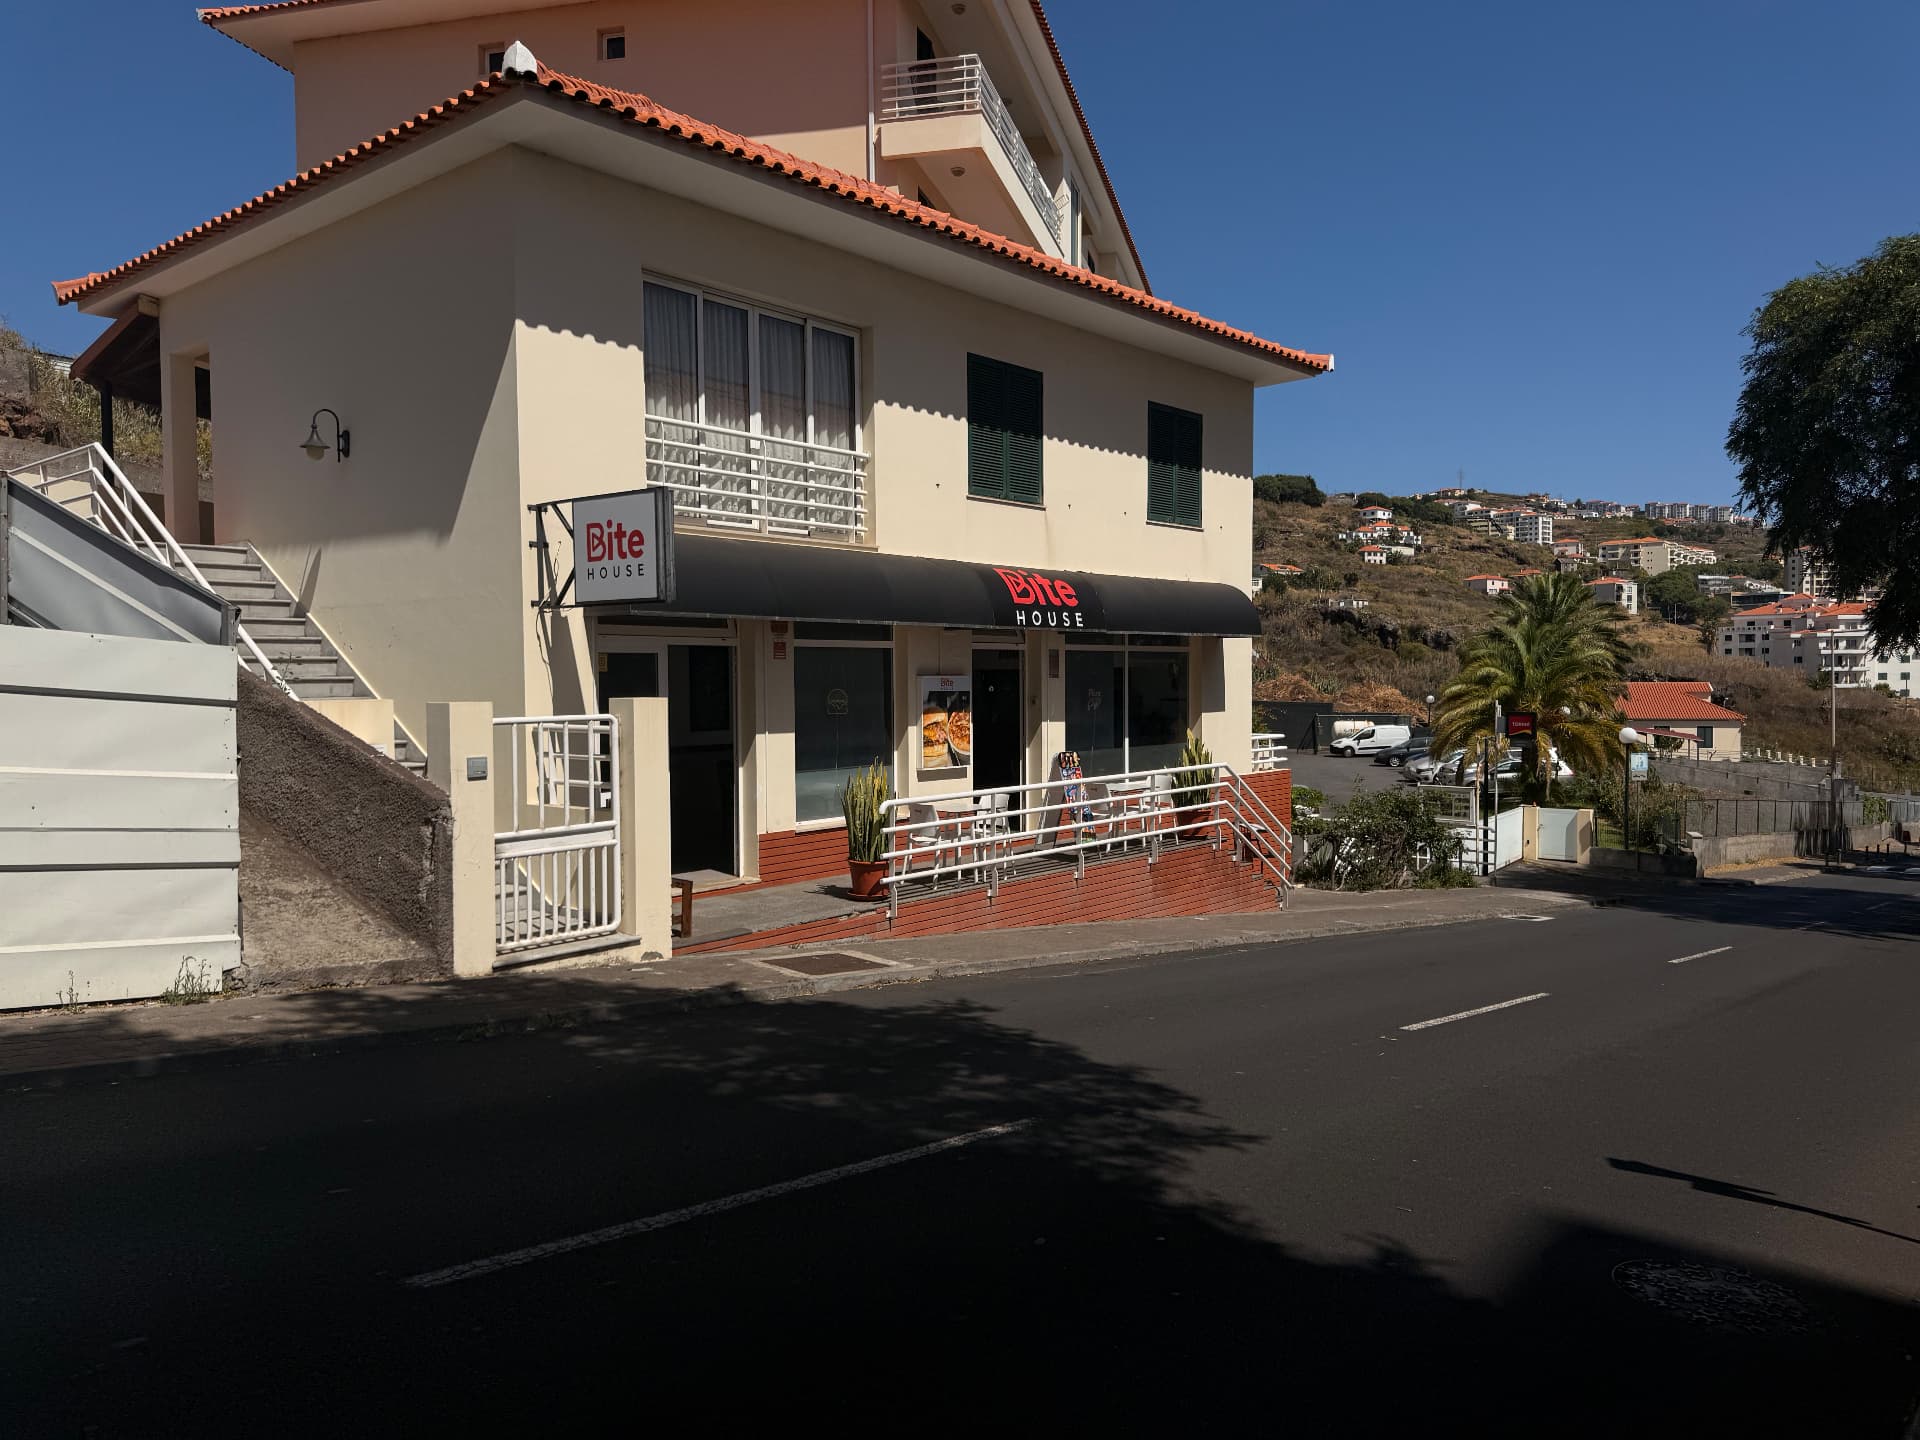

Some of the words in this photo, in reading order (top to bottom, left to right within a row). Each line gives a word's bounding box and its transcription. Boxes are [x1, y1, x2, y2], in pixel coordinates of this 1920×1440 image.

[586, 519, 645, 563] Bite
[587, 563, 645, 581] HOUSE
[992, 567, 1079, 607] Bite
[1016, 610, 1084, 627] HOUSE
